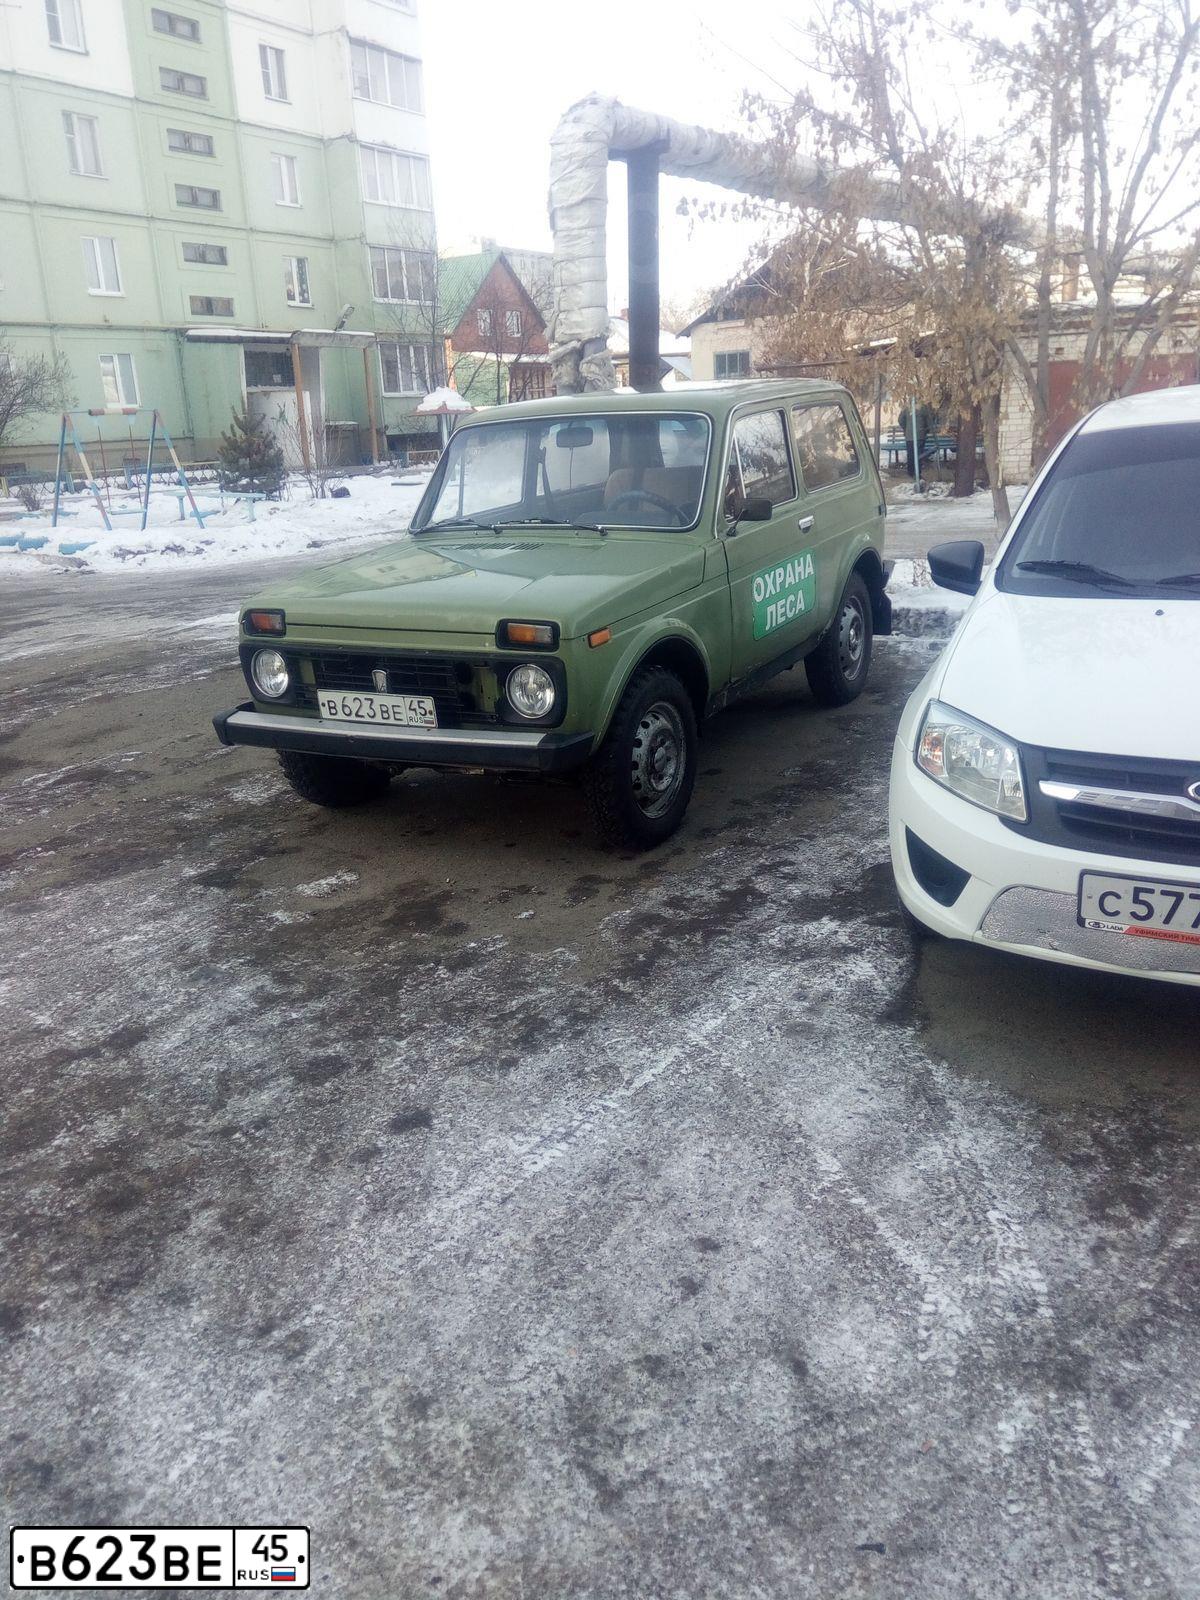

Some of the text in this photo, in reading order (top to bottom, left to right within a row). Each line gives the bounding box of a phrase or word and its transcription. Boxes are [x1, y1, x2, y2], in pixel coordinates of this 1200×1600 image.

[753, 554, 814, 602] ОХРАНА
[766, 590, 805, 631] ЛЕСА
[408, 700, 427, 716] 45
[408, 716, 424, 724] RUS
